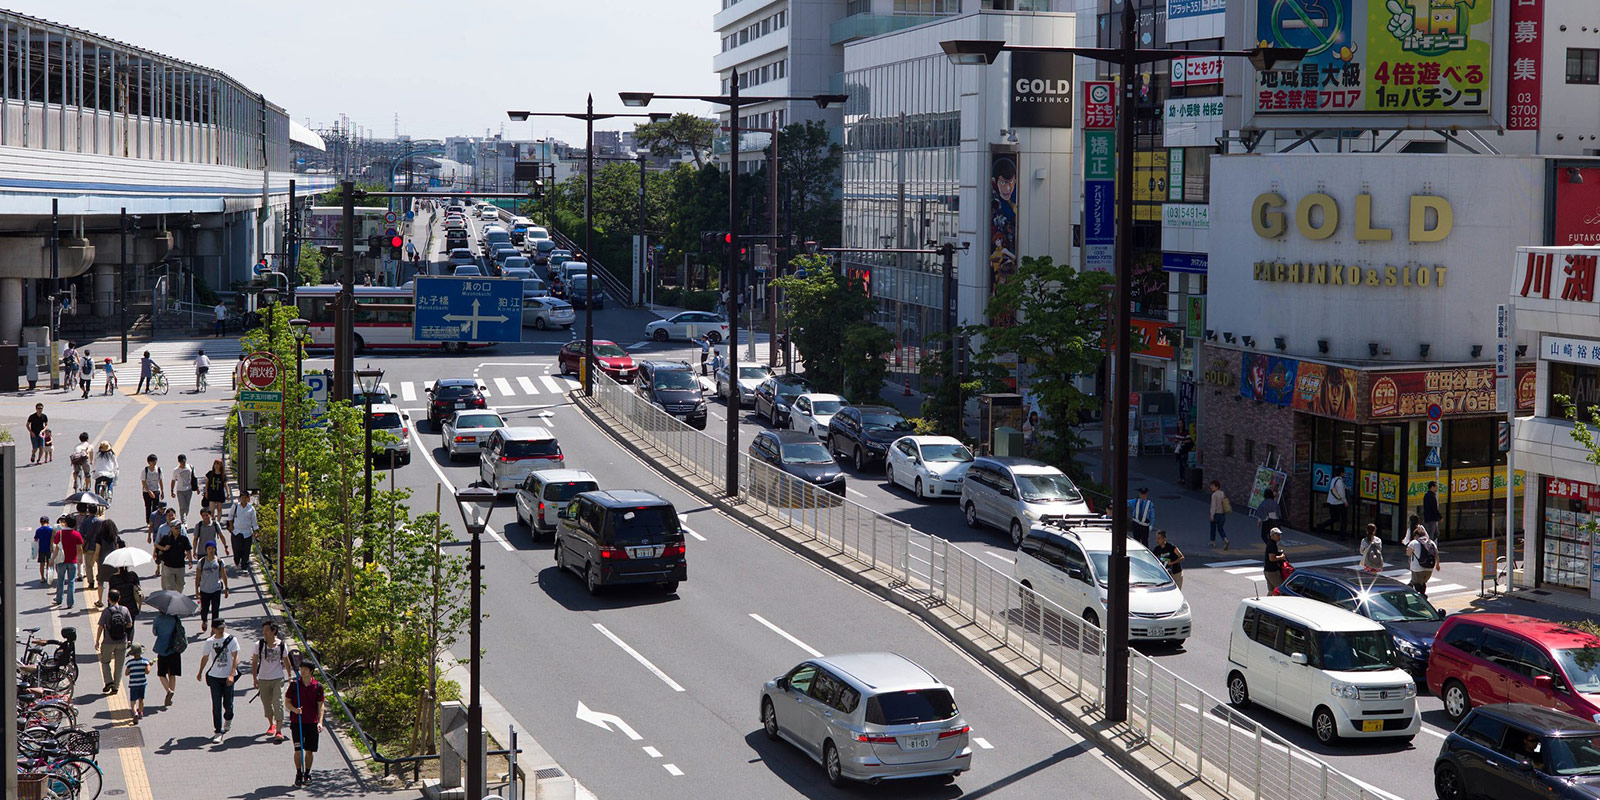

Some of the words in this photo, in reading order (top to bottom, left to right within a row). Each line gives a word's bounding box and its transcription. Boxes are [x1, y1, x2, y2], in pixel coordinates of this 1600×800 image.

[1260, 63, 1361, 88] 地域最大級
[1374, 61, 1483, 86] 4倍遊べる
[1016, 78, 1069, 94] GOLD
[1259, 90, 1361, 110] 完全禁煙フロア
[1376, 86, 1481, 107] 1円パチンコ
[1517, 93, 1531, 103] 03
[1087, 105, 1113, 115] こども
[1511, 105, 1537, 116] 3700
[1087, 115, 1113, 126] クラブ
[1511, 117, 1537, 128] 3123
[1091, 136, 1108, 175] 矯正
[1252, 193, 1453, 243] GOLD
[1568, 233, 1600, 241] FUTAKO
[1253, 263, 1448, 288] PACHINKO&SLOT
[462, 281, 491, 291] 溝の口
[418, 296, 448, 305] 丸子橋
[498, 297, 520, 307] 狛江
[250, 366, 274, 378] 消火栓
[1204, 370, 1229, 386] GOLD
[309, 378, 323, 398] P
[1426, 370, 1493, 391] 世田谷最大
[1375, 388, 1395, 404] 676
[1316, 468, 1330, 487] 2F
[1364, 476, 1377, 494] 1F
